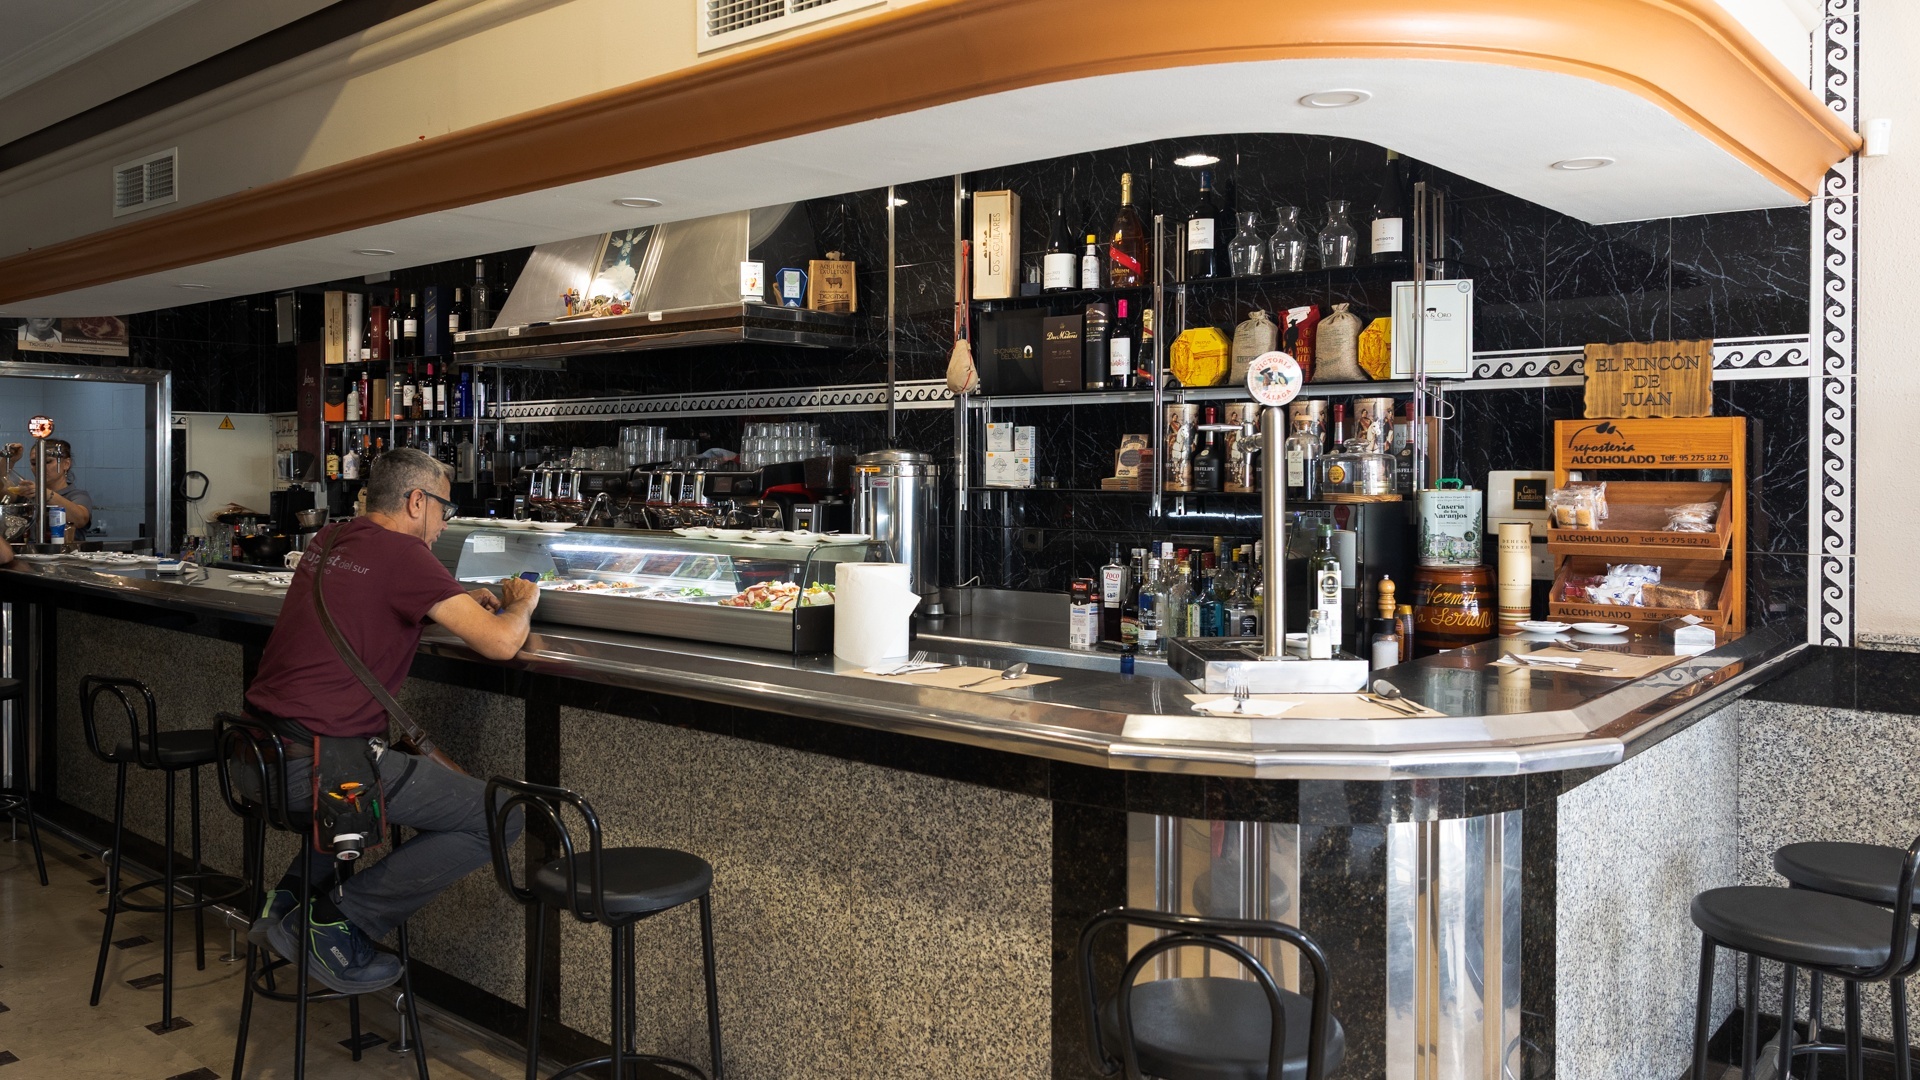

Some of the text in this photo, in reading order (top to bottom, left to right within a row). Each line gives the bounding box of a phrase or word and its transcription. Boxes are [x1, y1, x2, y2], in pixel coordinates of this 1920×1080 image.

[992, 212, 1000, 276] LOS AGUILARES
[993, 346, 1022, 354] ENCINARES
[1256, 357, 1292, 372] VICTORIA
[1595, 352, 1701, 372] EL RINCÓN
[1633, 374, 1661, 388] DE
[1621, 391, 1673, 406] JUAN
[1571, 455, 1656, 464] ALCOHOLADO
[1517, 491, 1544, 500] Puntales
[1522, 485, 1537, 494] Casa
[1434, 512, 1468, 520] Naranjos
[1556, 534, 1629, 543] ALCOHOLADO
[338, 559, 354, 570] del
[352, 563, 370, 575] sur
[1424, 583, 1478, 605] Vermut
[1558, 607, 1632, 619] ALCOHOLADO
